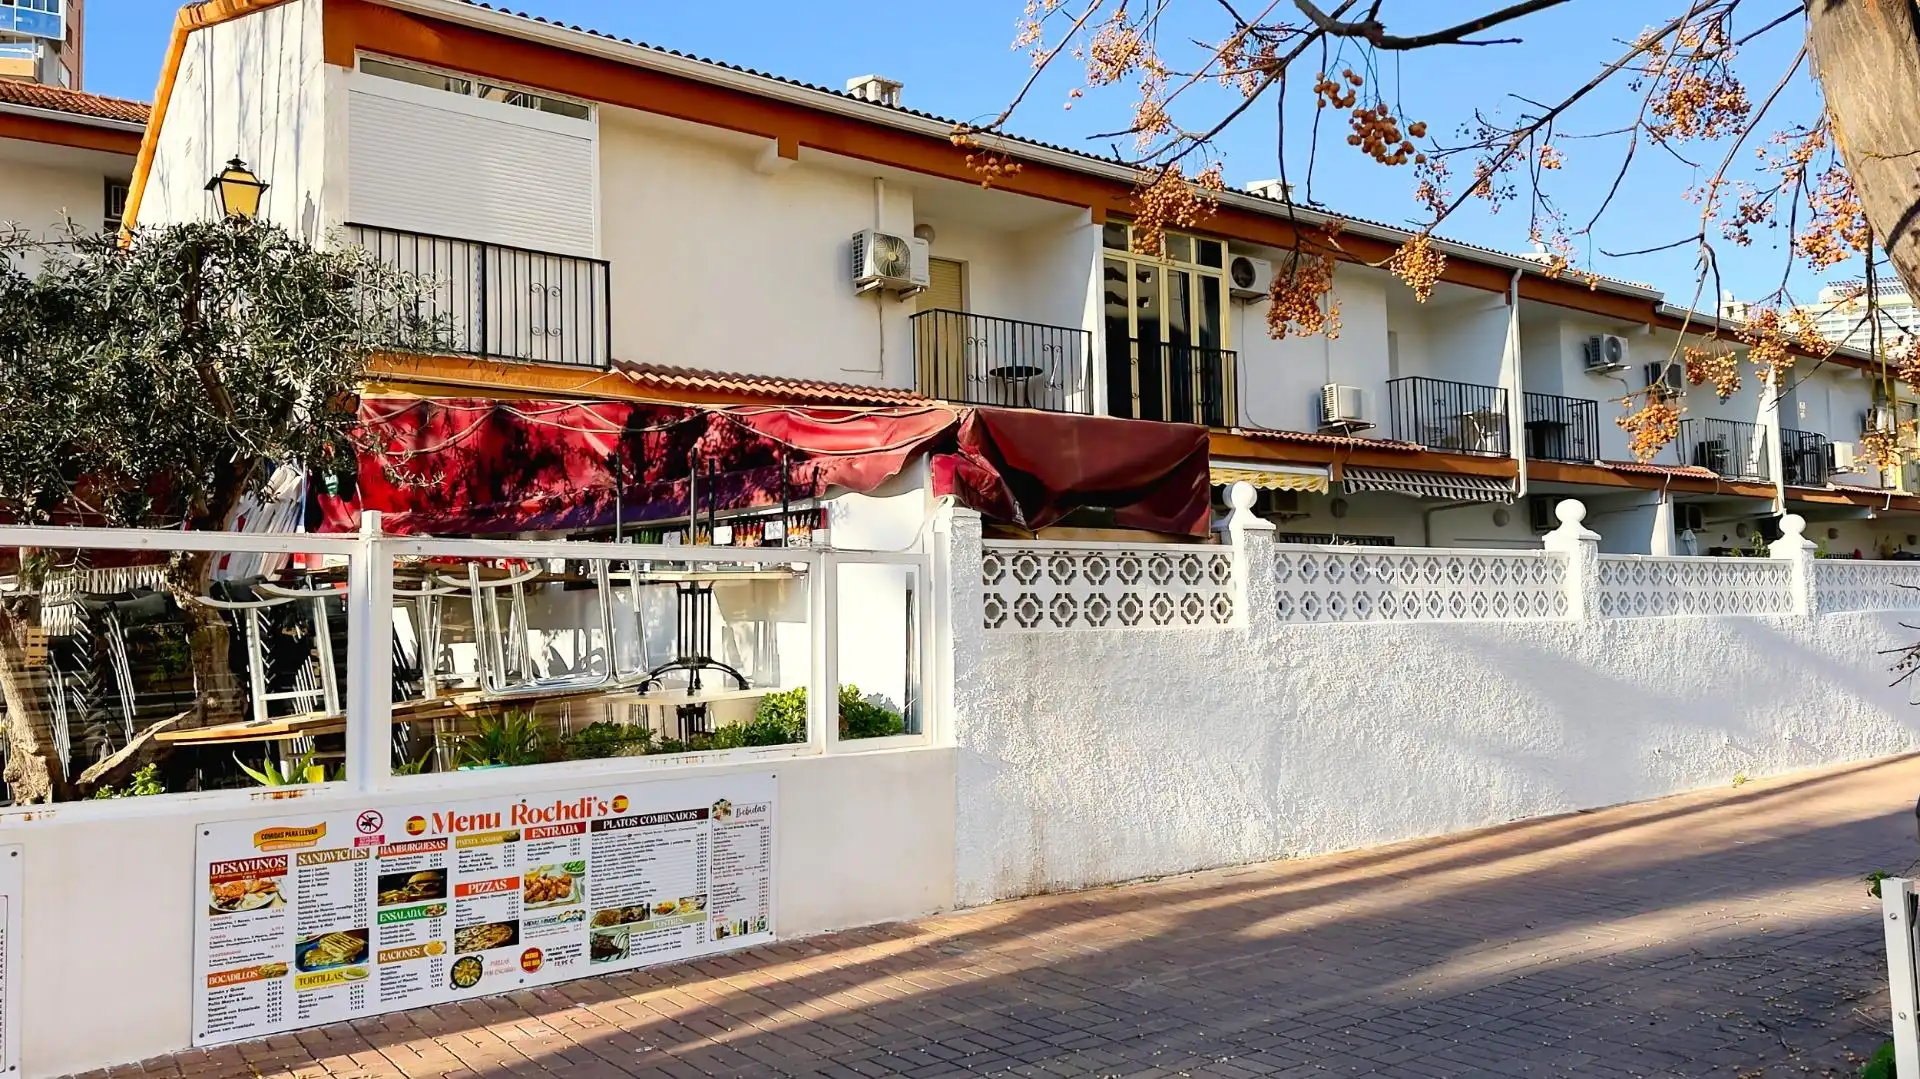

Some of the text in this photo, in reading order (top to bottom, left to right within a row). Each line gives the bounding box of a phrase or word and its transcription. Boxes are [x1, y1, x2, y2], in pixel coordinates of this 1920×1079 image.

[432, 796, 608, 834] Menu Rochdi's
[736, 804, 766, 818] Bebidas
[603, 811, 698, 830] PLATOS COMBINADOS
[261, 828, 318, 840] COMIDAS PARA LLEVAR
[532, 824, 579, 839] ENTRADA
[380, 840, 446, 855] HAMBURGUESAS
[212, 856, 287, 875] DESAYUNOS
[298, 850, 369, 866] SANDWICHES
[468, 880, 508, 894] PIZZAS
[380, 908, 422, 922] ENSALADA
[380, 948, 420, 962] RACIONES
[209, 970, 258, 985] BOCADILLOS
[298, 972, 343, 986] TORTILLAS
